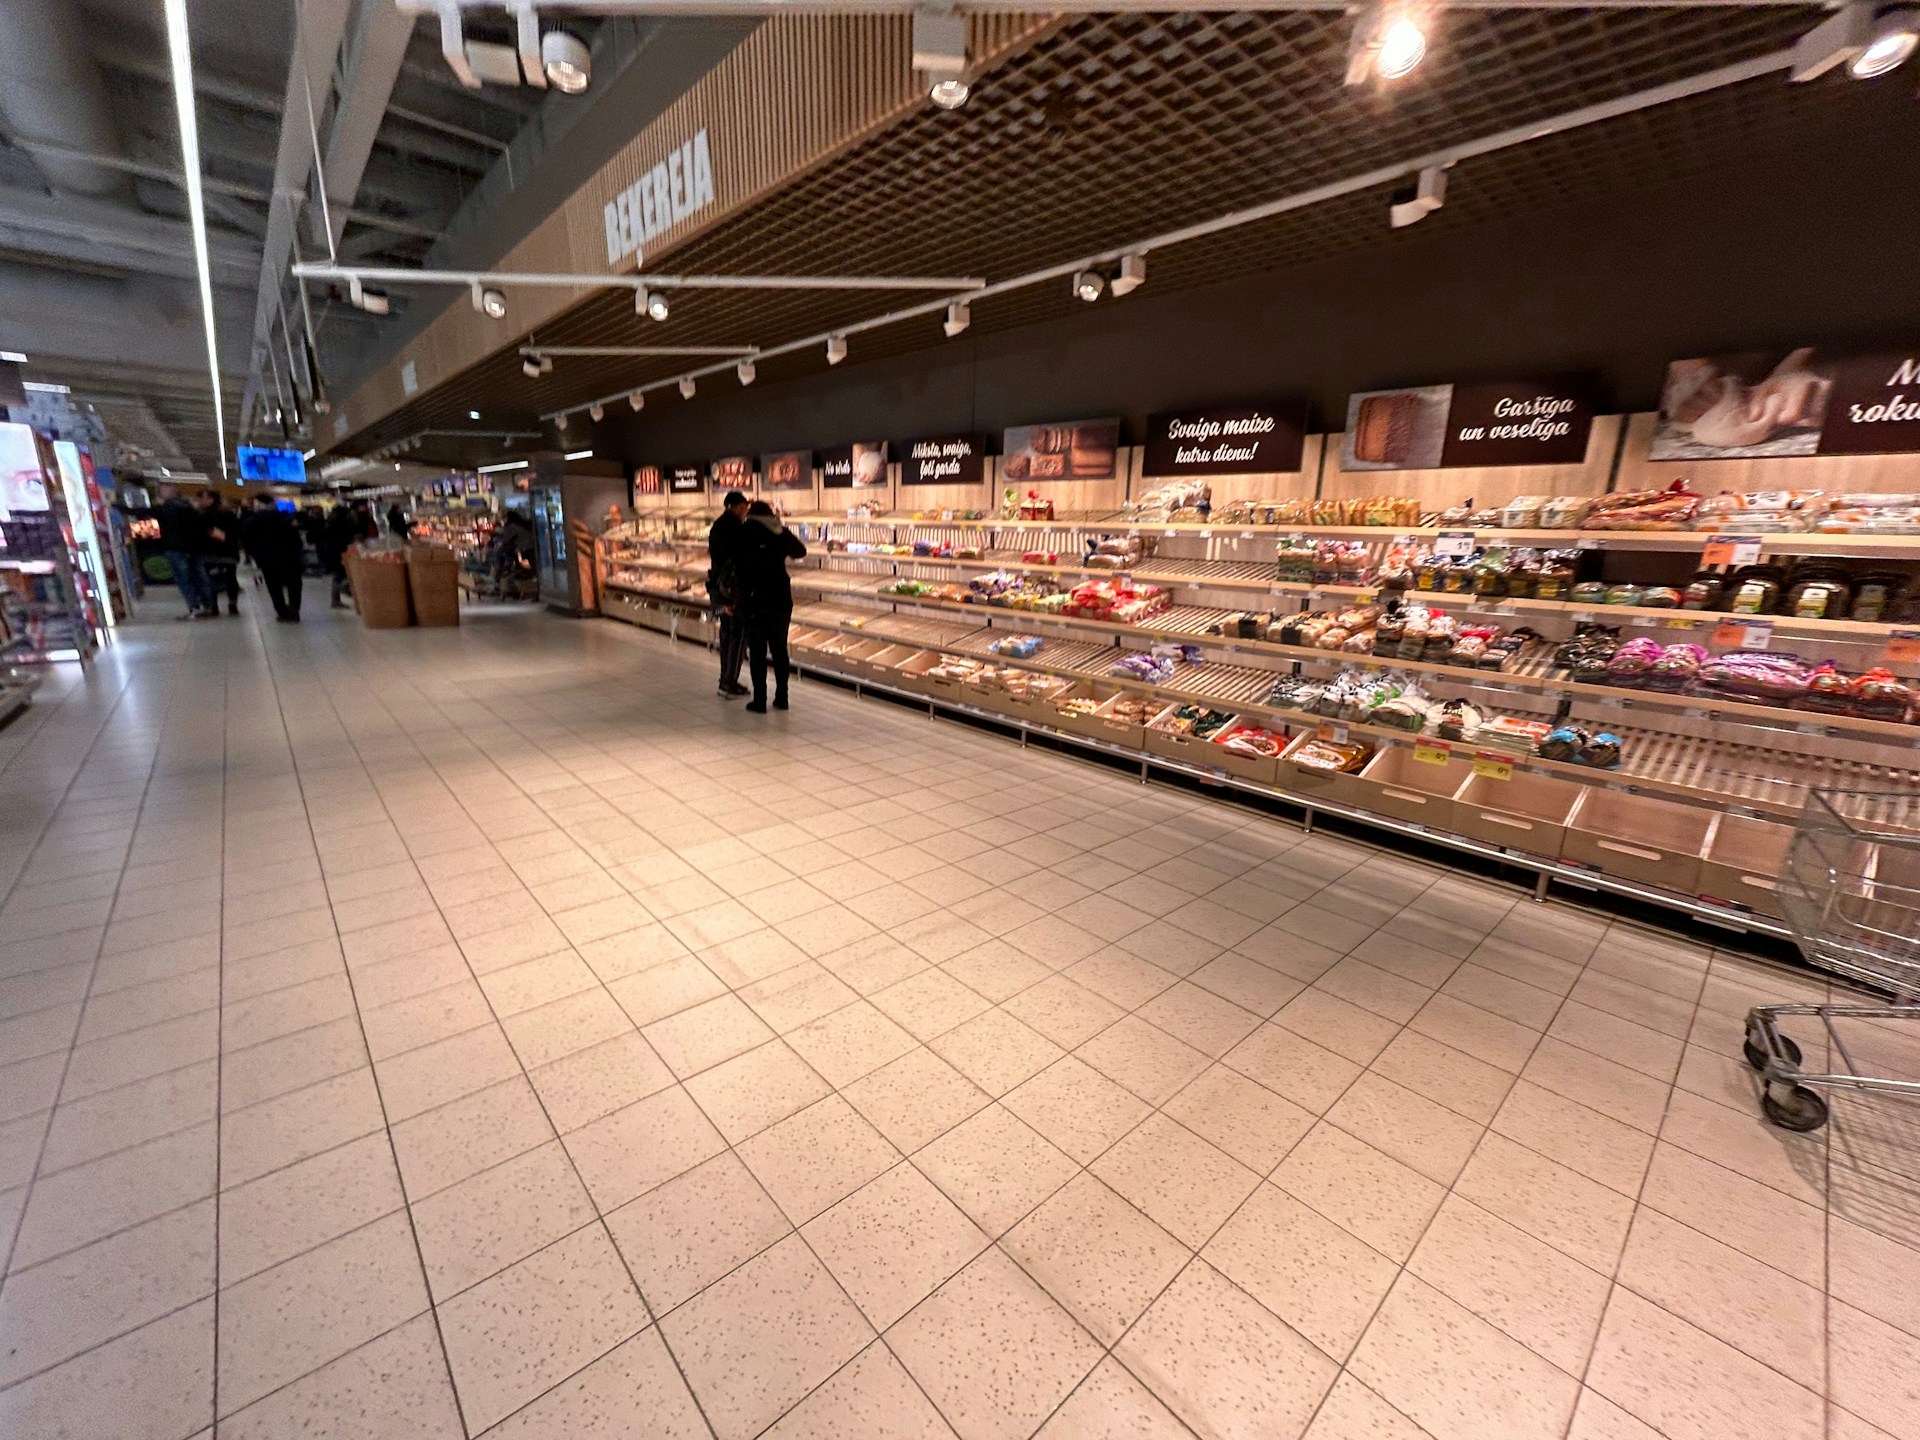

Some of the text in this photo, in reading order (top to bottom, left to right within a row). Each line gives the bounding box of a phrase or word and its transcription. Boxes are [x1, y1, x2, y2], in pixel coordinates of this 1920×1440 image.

[1494, 395, 1576, 419] Garšīga
[1168, 412, 1275, 442] Svaiga maize
[1459, 417, 1571, 441] un veselīga
[1174, 441, 1259, 464] katru dienu!
[934, 457, 961, 480] garda
